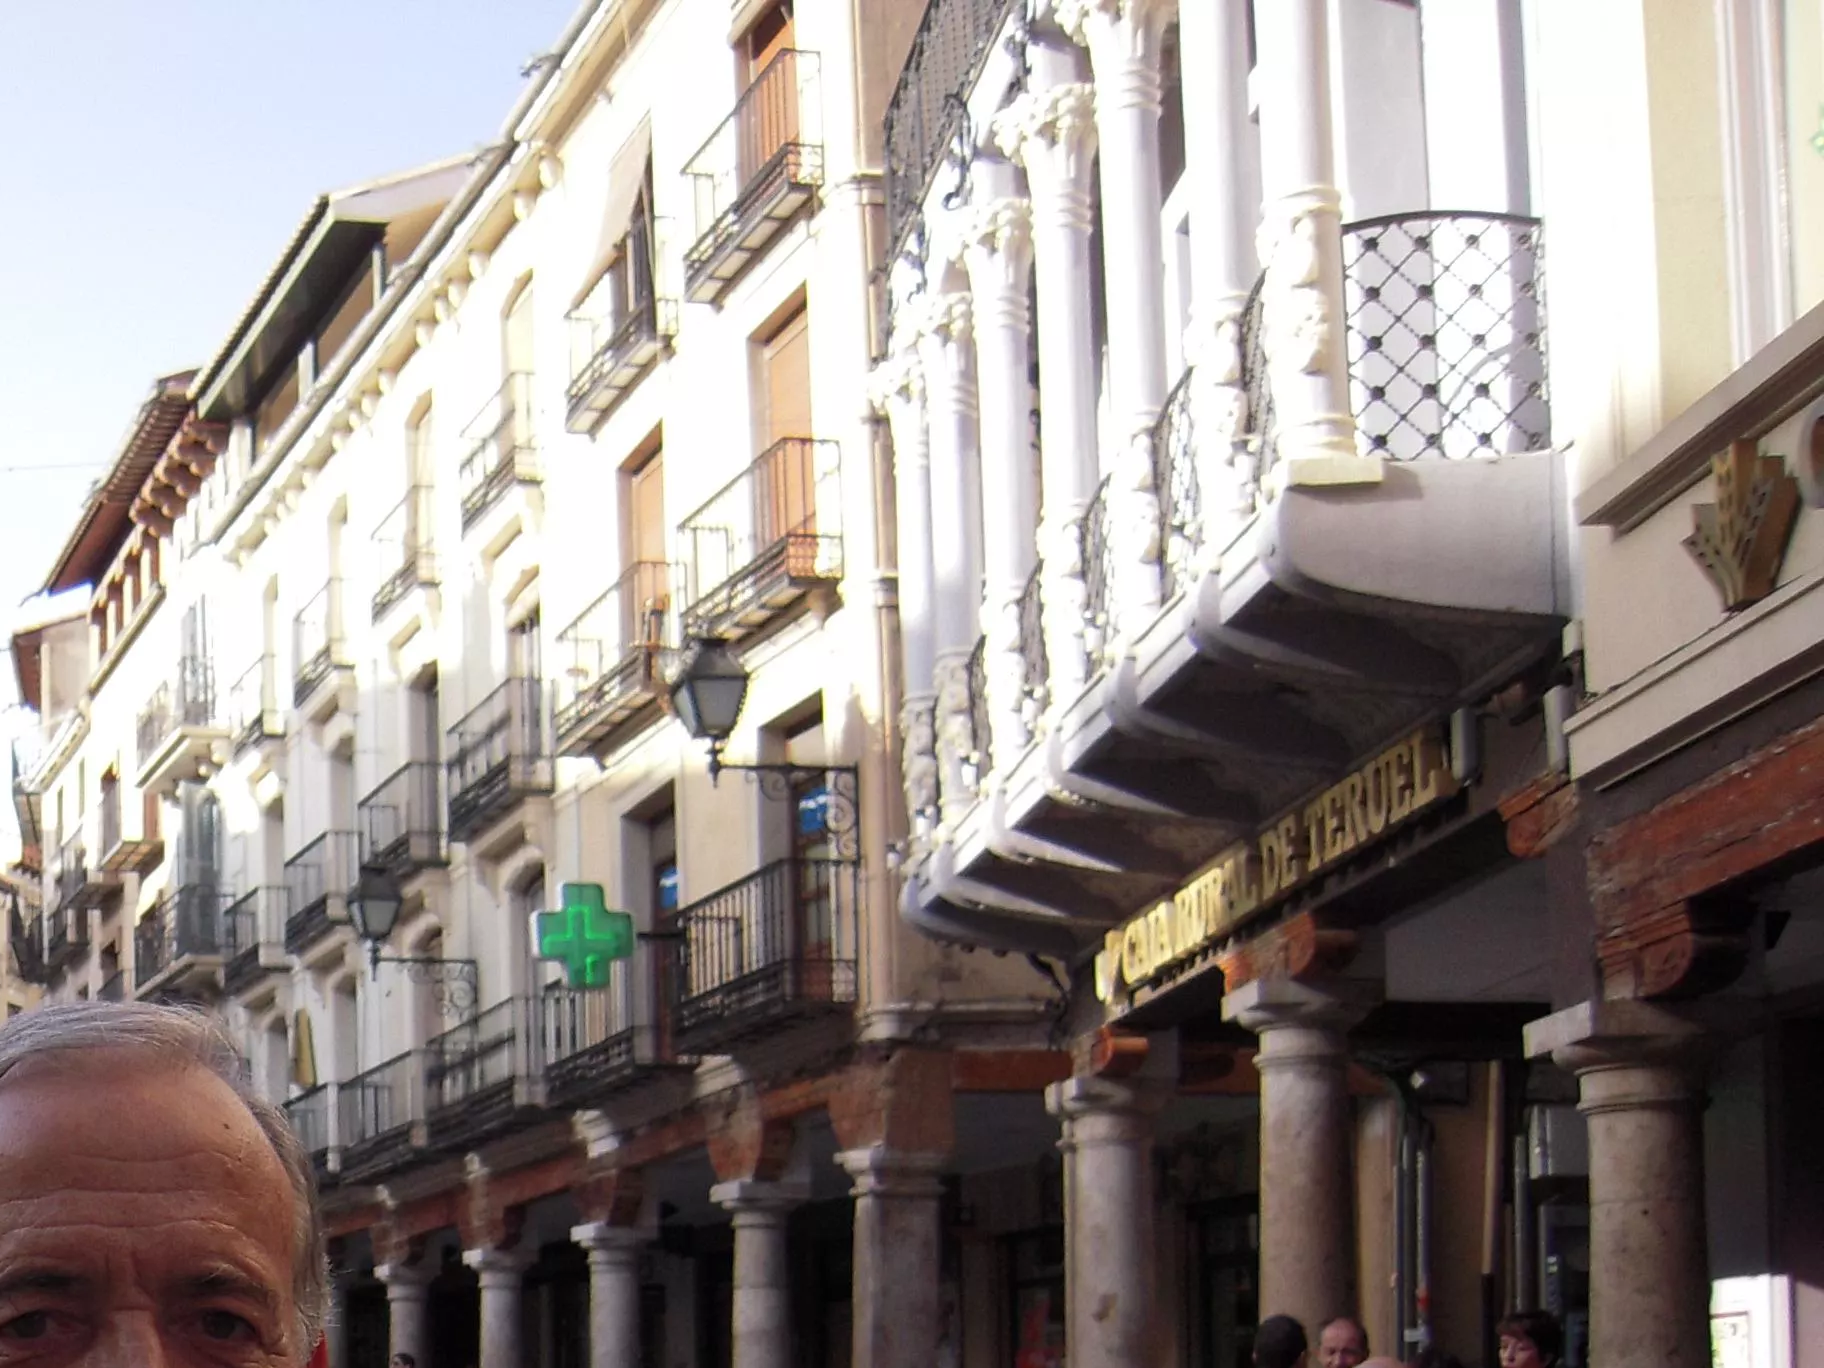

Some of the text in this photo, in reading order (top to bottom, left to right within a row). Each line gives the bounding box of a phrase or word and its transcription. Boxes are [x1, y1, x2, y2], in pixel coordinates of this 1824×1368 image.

[1122, 731, 1440, 985] CAJA RURAL DE TERUEL
